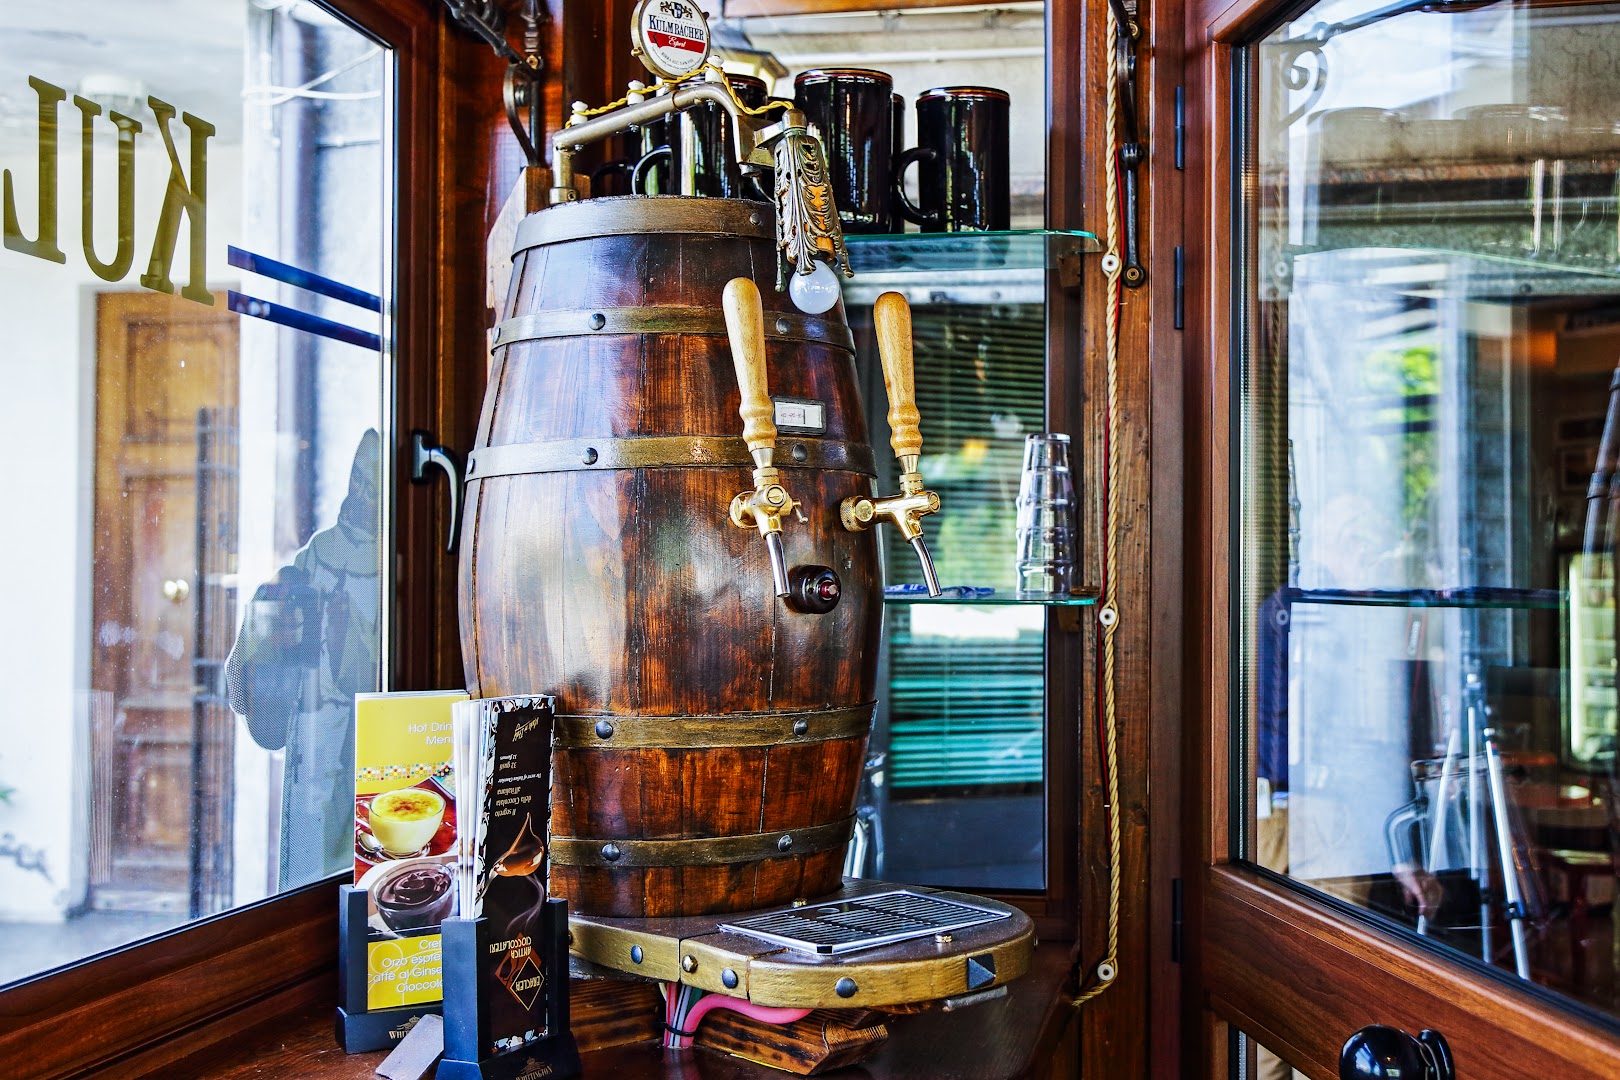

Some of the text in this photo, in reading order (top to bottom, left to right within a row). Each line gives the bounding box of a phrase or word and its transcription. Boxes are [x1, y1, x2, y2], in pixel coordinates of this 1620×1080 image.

[649, 14, 704, 41] KULMBACHER
[409, 723, 428, 733] Hot
[510, 945, 532, 959] ANTICA
[382, 957, 408, 969] Orzo
[399, 969, 410, 980] al
[515, 975, 541, 992] ERACLEA
